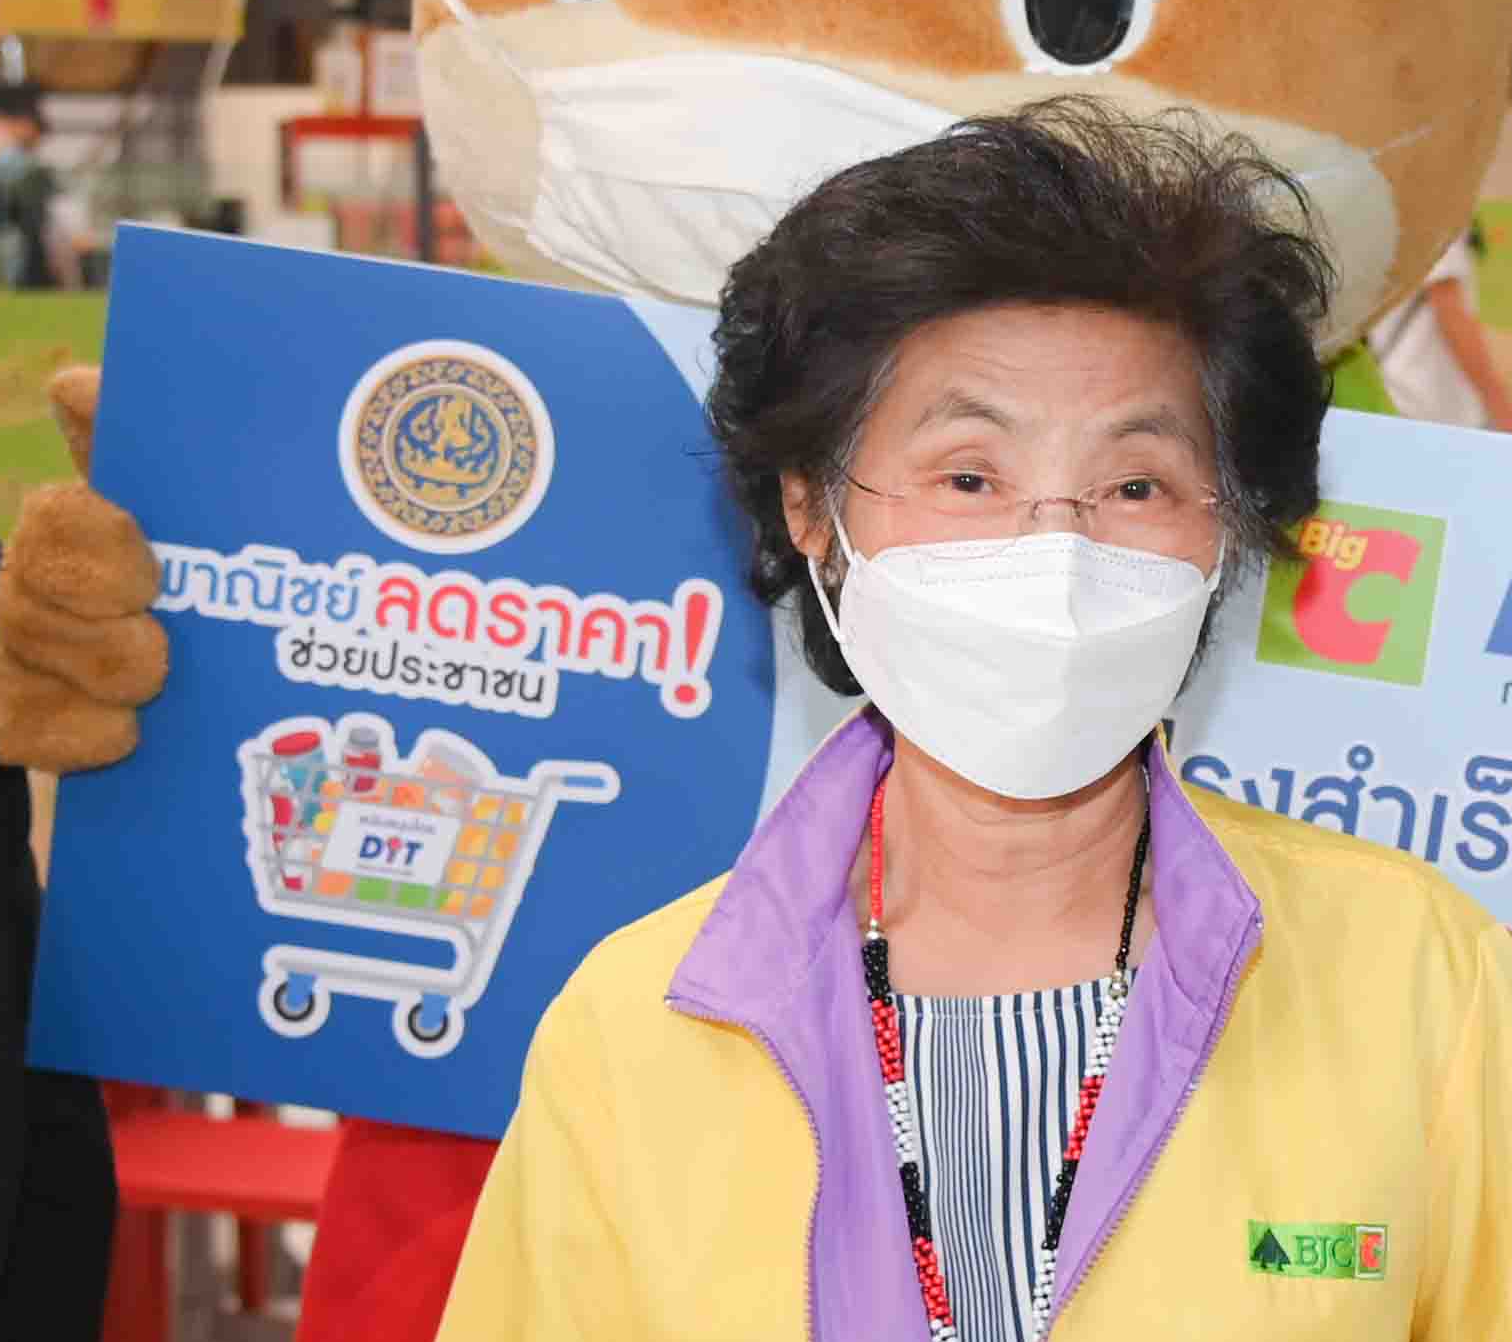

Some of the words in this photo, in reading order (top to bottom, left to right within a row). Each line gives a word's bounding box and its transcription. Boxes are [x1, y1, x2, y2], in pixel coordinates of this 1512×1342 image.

[1298, 516, 1370, 571] Big
[1291, 527, 1424, 666] C
[289, 626, 546, 706] ช่วยประชาชน
[375, 573, 710, 705] ลดราคา!
[359, 834, 426, 867] DIT
[1295, 1233, 1353, 1275] BJC
